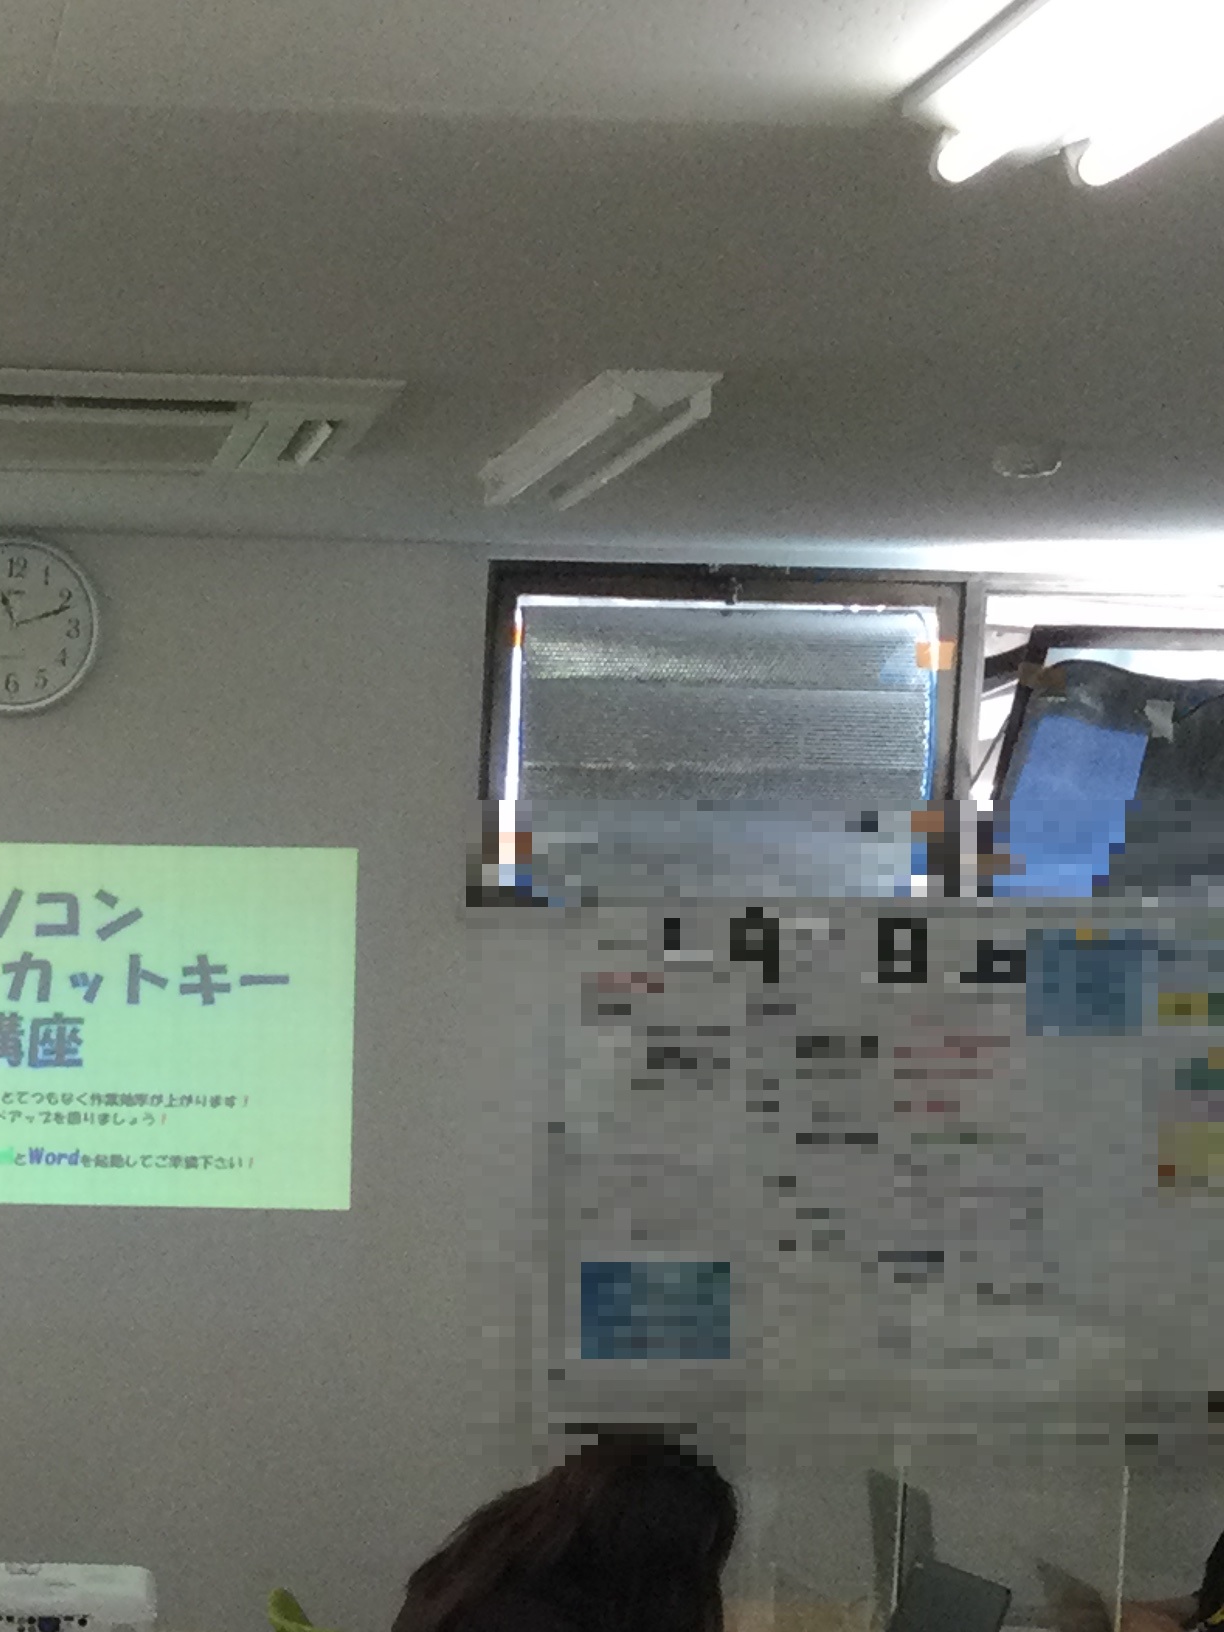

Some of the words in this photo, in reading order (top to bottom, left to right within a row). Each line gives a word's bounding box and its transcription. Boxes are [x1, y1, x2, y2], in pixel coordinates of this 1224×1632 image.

[7, 557, 27, 579] 12
[43, 565, 51, 586] 1
[58, 587, 73, 608] 2
[65, 617, 80, 639] 3
[54, 647, 68, 667] 4
[4, 672, 20, 694] 6
[34, 668, 49, 690] 5
